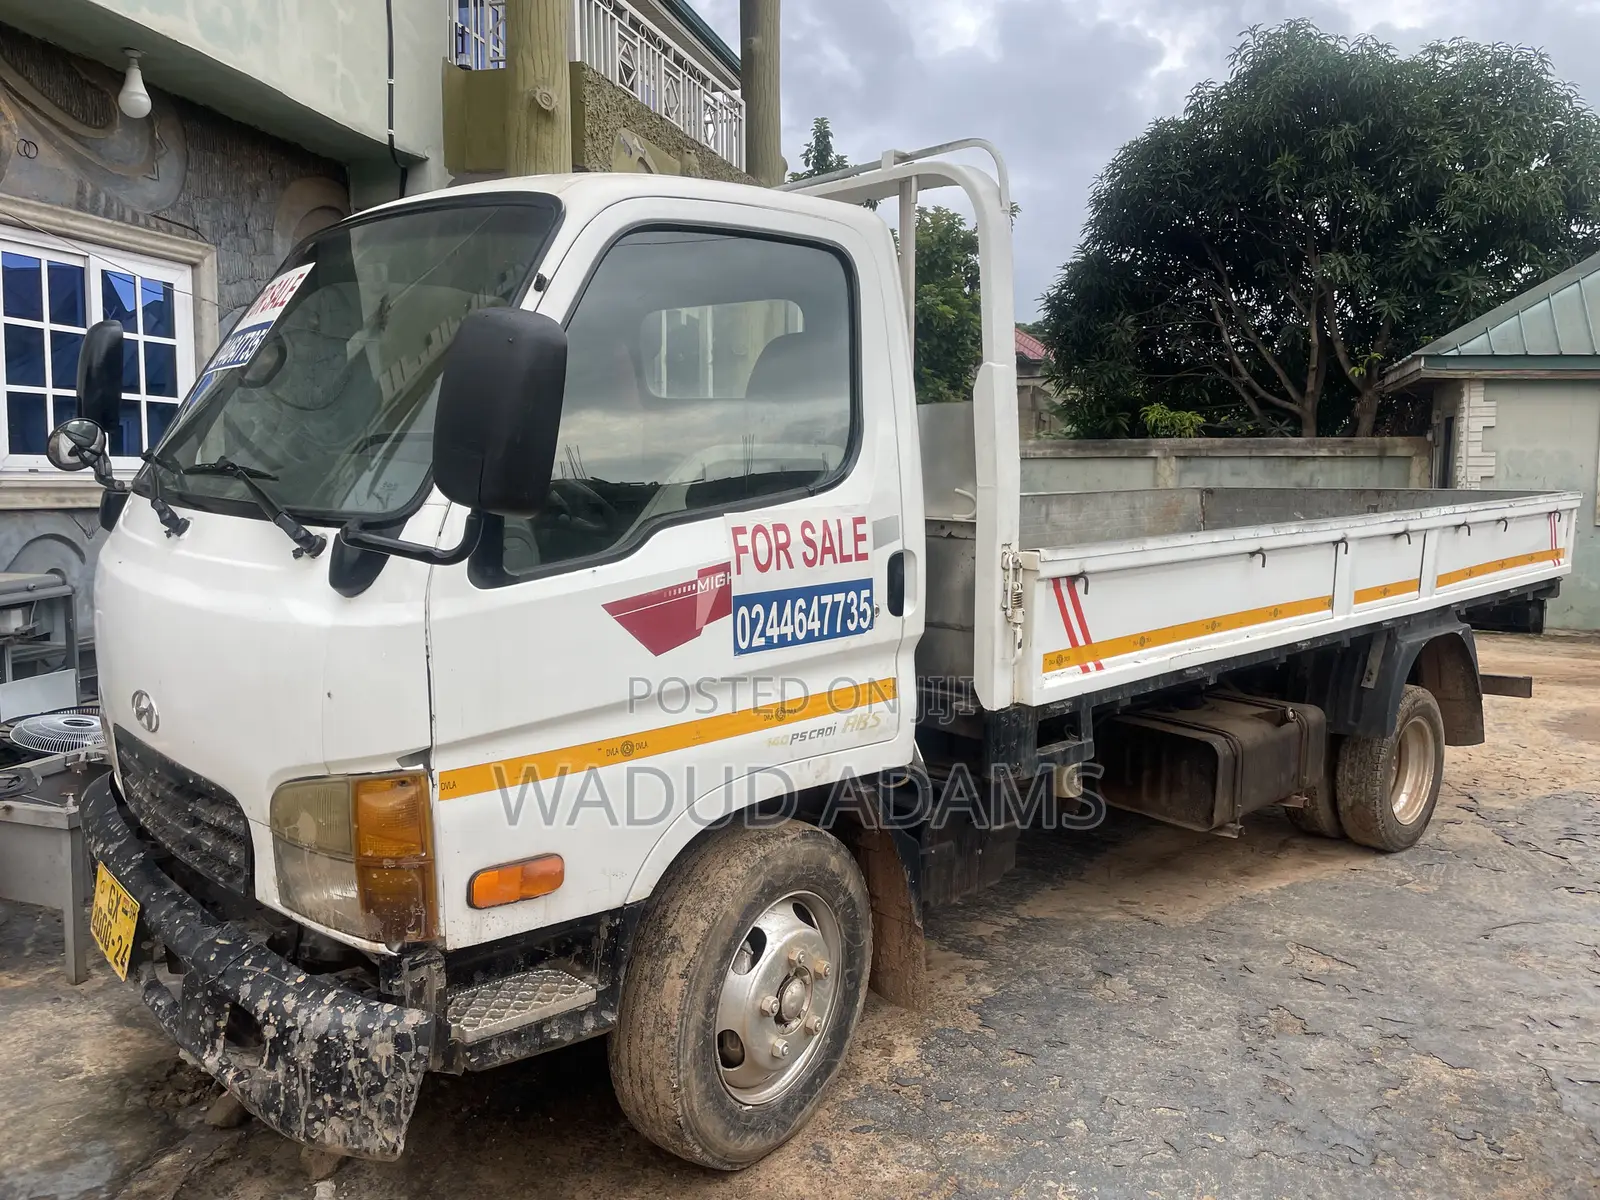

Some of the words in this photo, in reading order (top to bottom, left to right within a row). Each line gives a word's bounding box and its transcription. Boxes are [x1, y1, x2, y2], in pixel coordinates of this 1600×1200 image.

[731, 522, 795, 576] FOR
[800, 516, 869, 568] SALE
[736, 589, 872, 650] 0244647735
[441, 781, 457, 791] DVLA
[107, 884, 122, 924] GX
